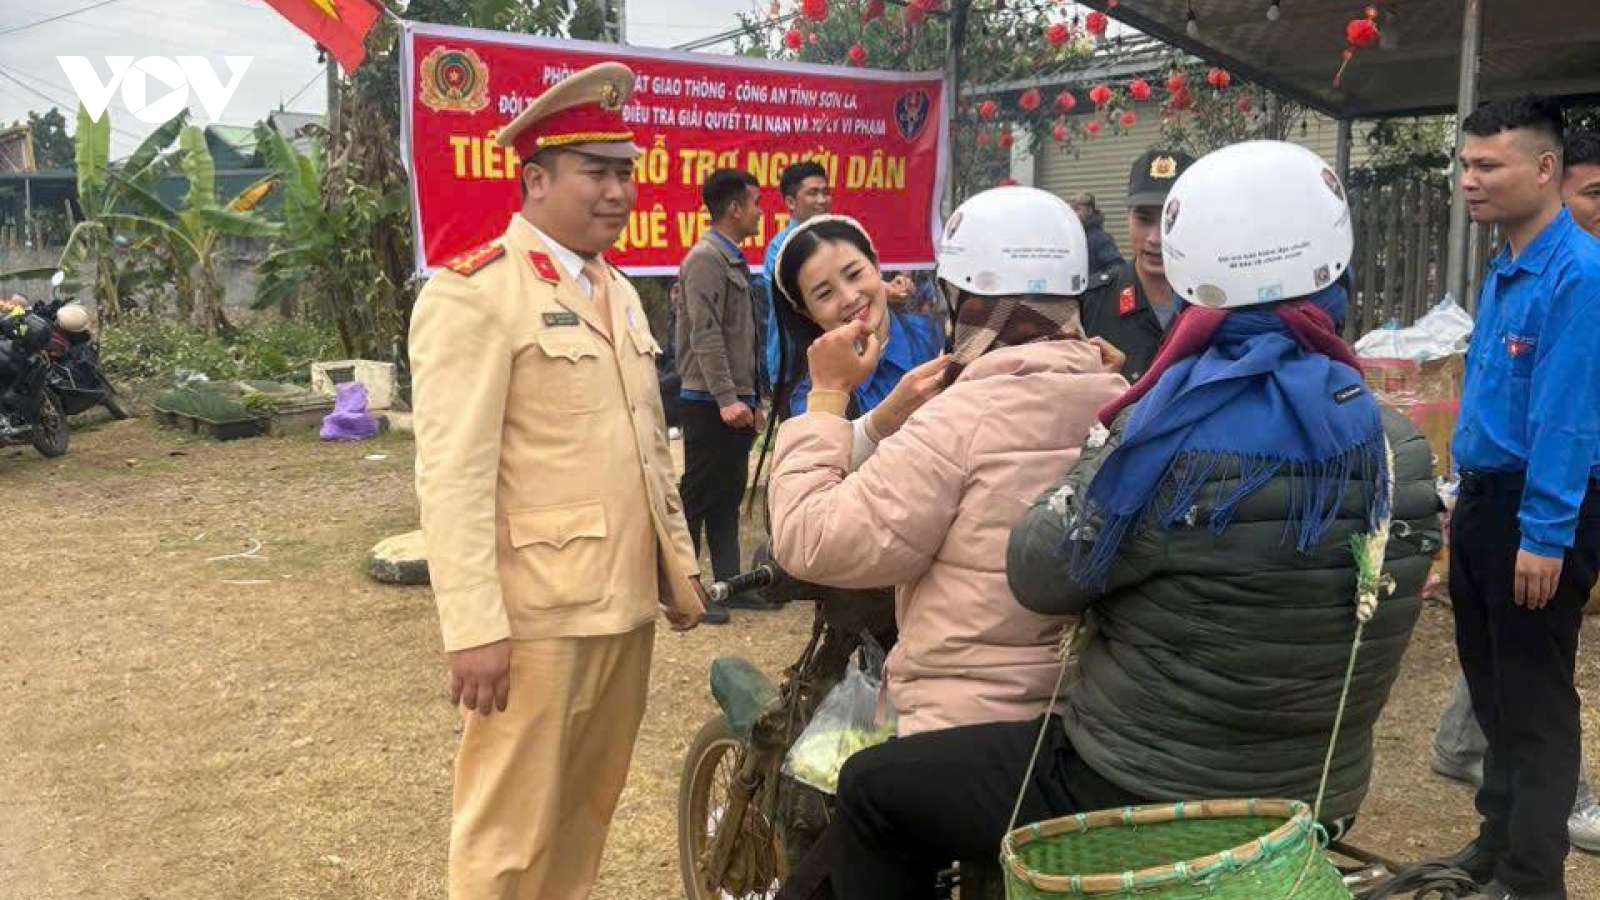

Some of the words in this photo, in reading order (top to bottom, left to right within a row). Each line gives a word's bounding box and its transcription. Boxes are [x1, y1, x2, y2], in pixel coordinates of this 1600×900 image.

[543, 63, 575, 84] PHÒ
[633, 70, 650, 92] ÁT
[652, 76, 682, 95] GIAO
[685, 77, 726, 99] THÔNG
[735, 80, 768, 103] CÔNG
[770, 87, 787, 104] AN
[790, 83, 817, 106] TỈNH
[818, 91, 840, 109] SƠN
[844, 93, 857, 110] LA
[622, 99, 650, 122] ĐIỀU
[652, 107, 675, 126] TRA
[678, 103, 702, 127] GIẢI
[705, 107, 741, 130] QUYẾT
[745, 114, 762, 132] TAI
[765, 115, 790, 136] NẠN
[854, 118, 886, 138] PHẠM
[748, 145, 838, 188] NGI
[846, 150, 905, 189] DÂN
